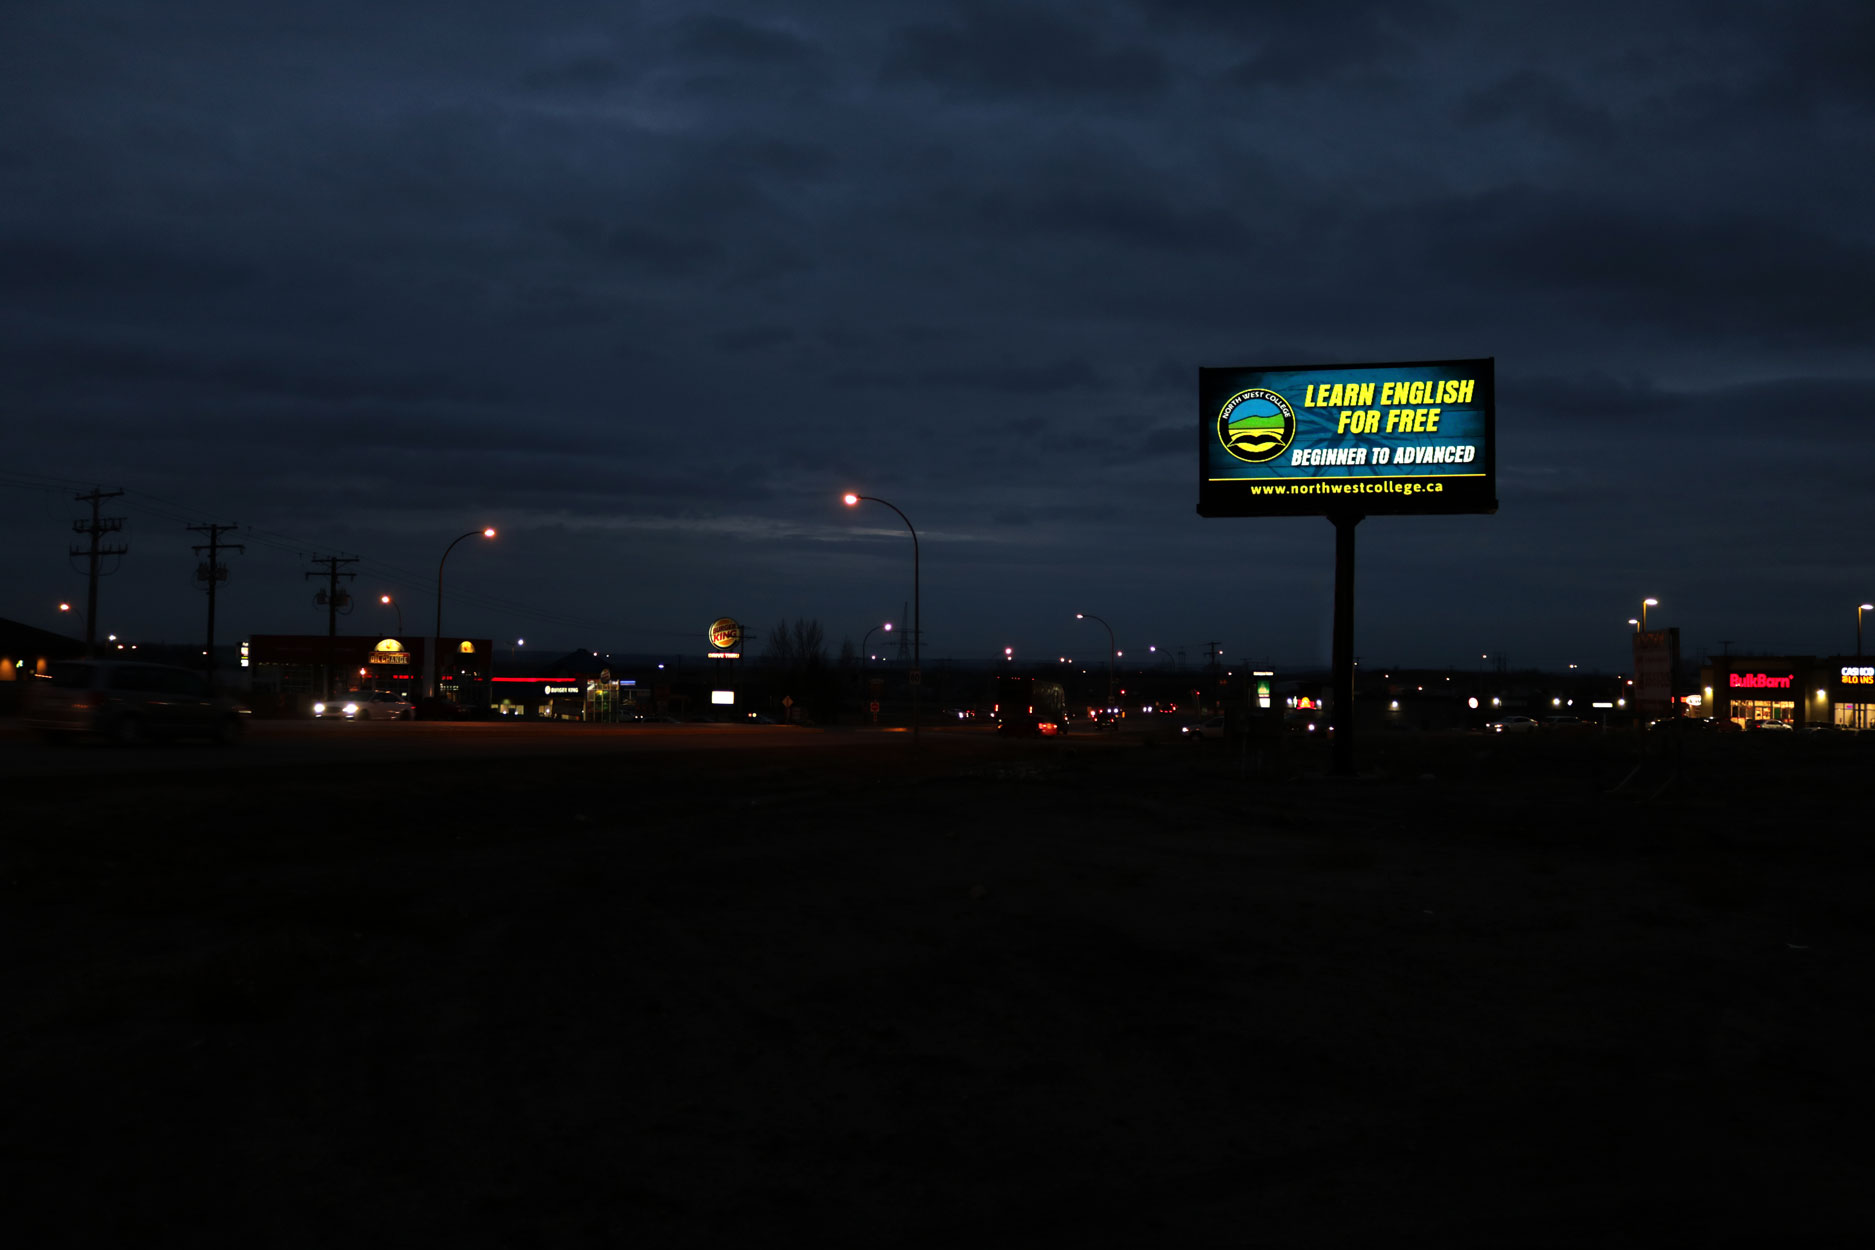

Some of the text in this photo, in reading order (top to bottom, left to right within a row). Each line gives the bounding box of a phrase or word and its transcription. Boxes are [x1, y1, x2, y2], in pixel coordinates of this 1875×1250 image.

[1304, 379, 1475, 407] LEARN ENGLISH
[1222, 391, 1291, 419] NORTH WEST COLLEGE
[1337, 408, 1441, 434] FOR FREE
[1291, 445, 1475, 466] BEGINNER TO ADVANCED
[1251, 481, 1443, 496] www.northwestcollege.ca
[713, 630, 737, 643] KING
[382, 655, 408, 664] CHANGE
